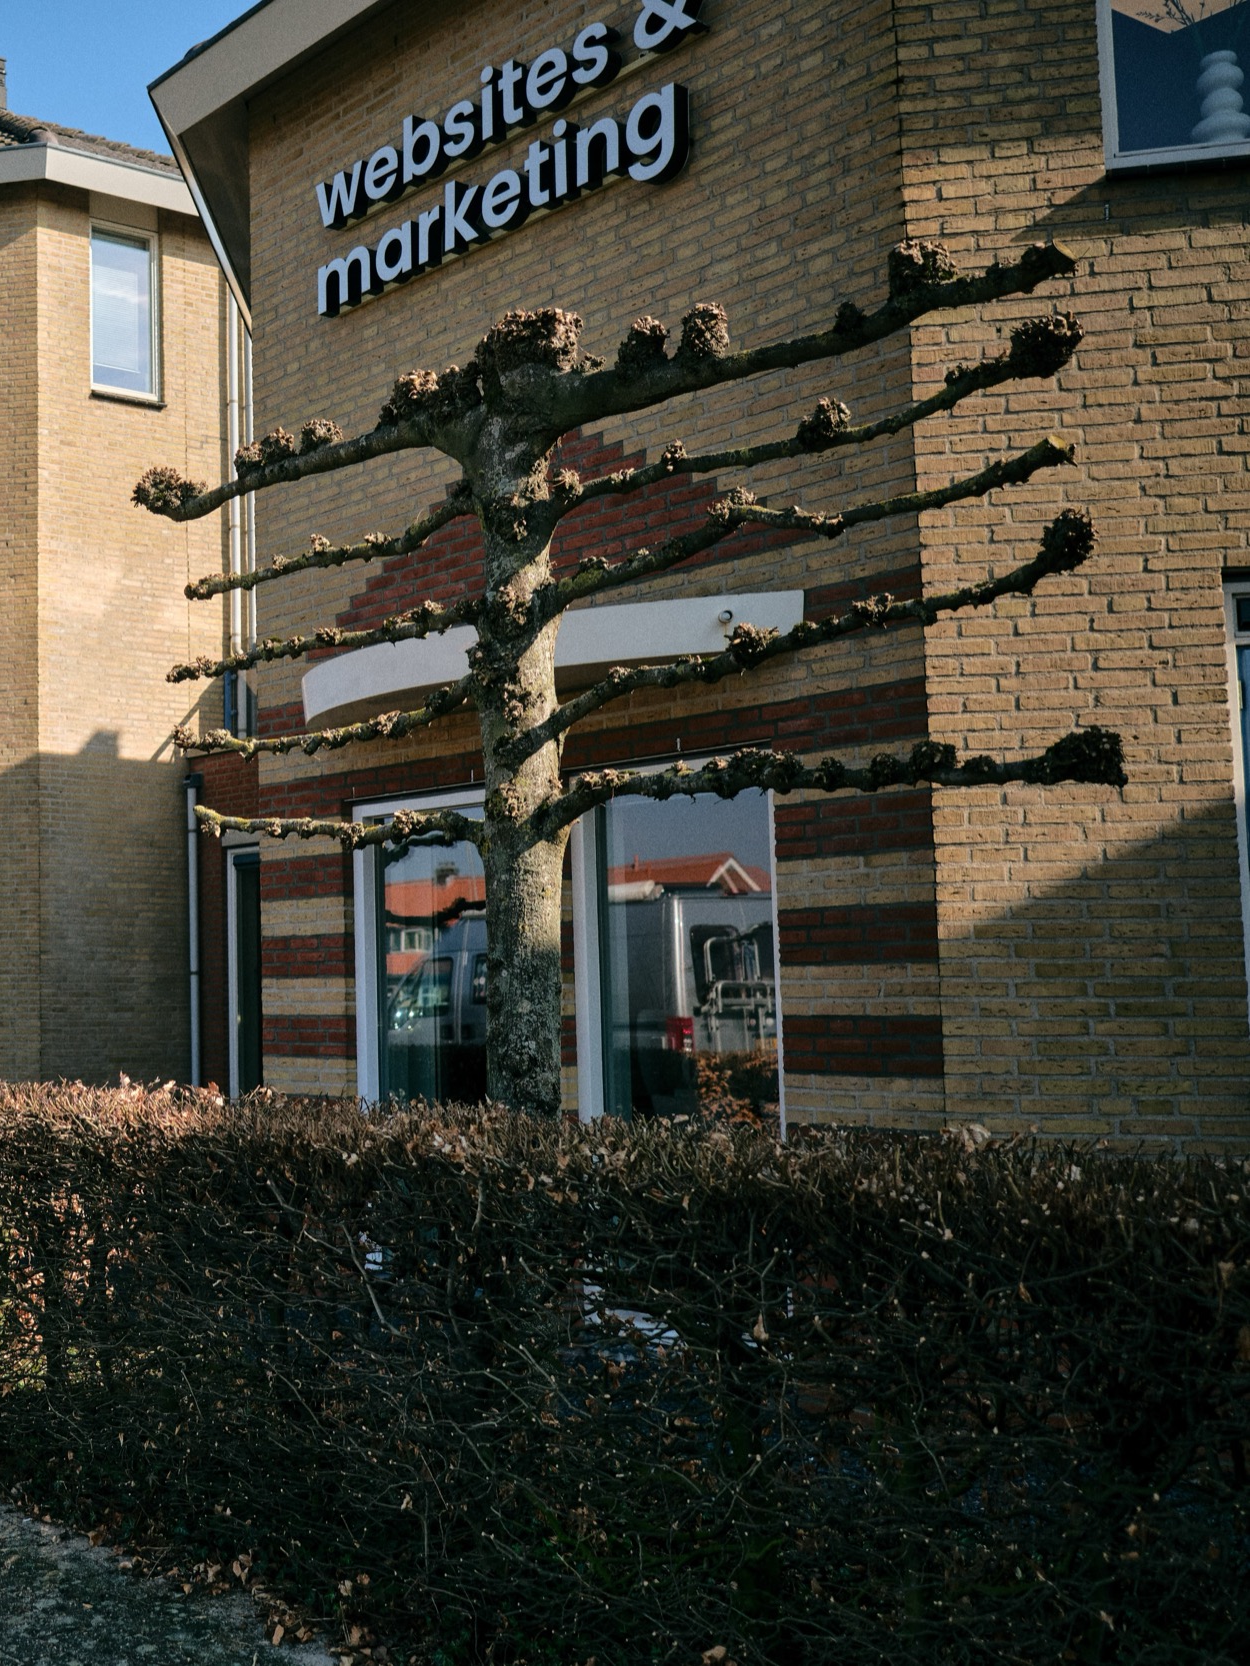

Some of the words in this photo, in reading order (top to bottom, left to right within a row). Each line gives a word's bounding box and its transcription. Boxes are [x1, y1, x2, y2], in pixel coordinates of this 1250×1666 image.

[315, 22, 609, 229] websites
[633, 0, 697, 50] &
[317, 82, 679, 316] marketing
